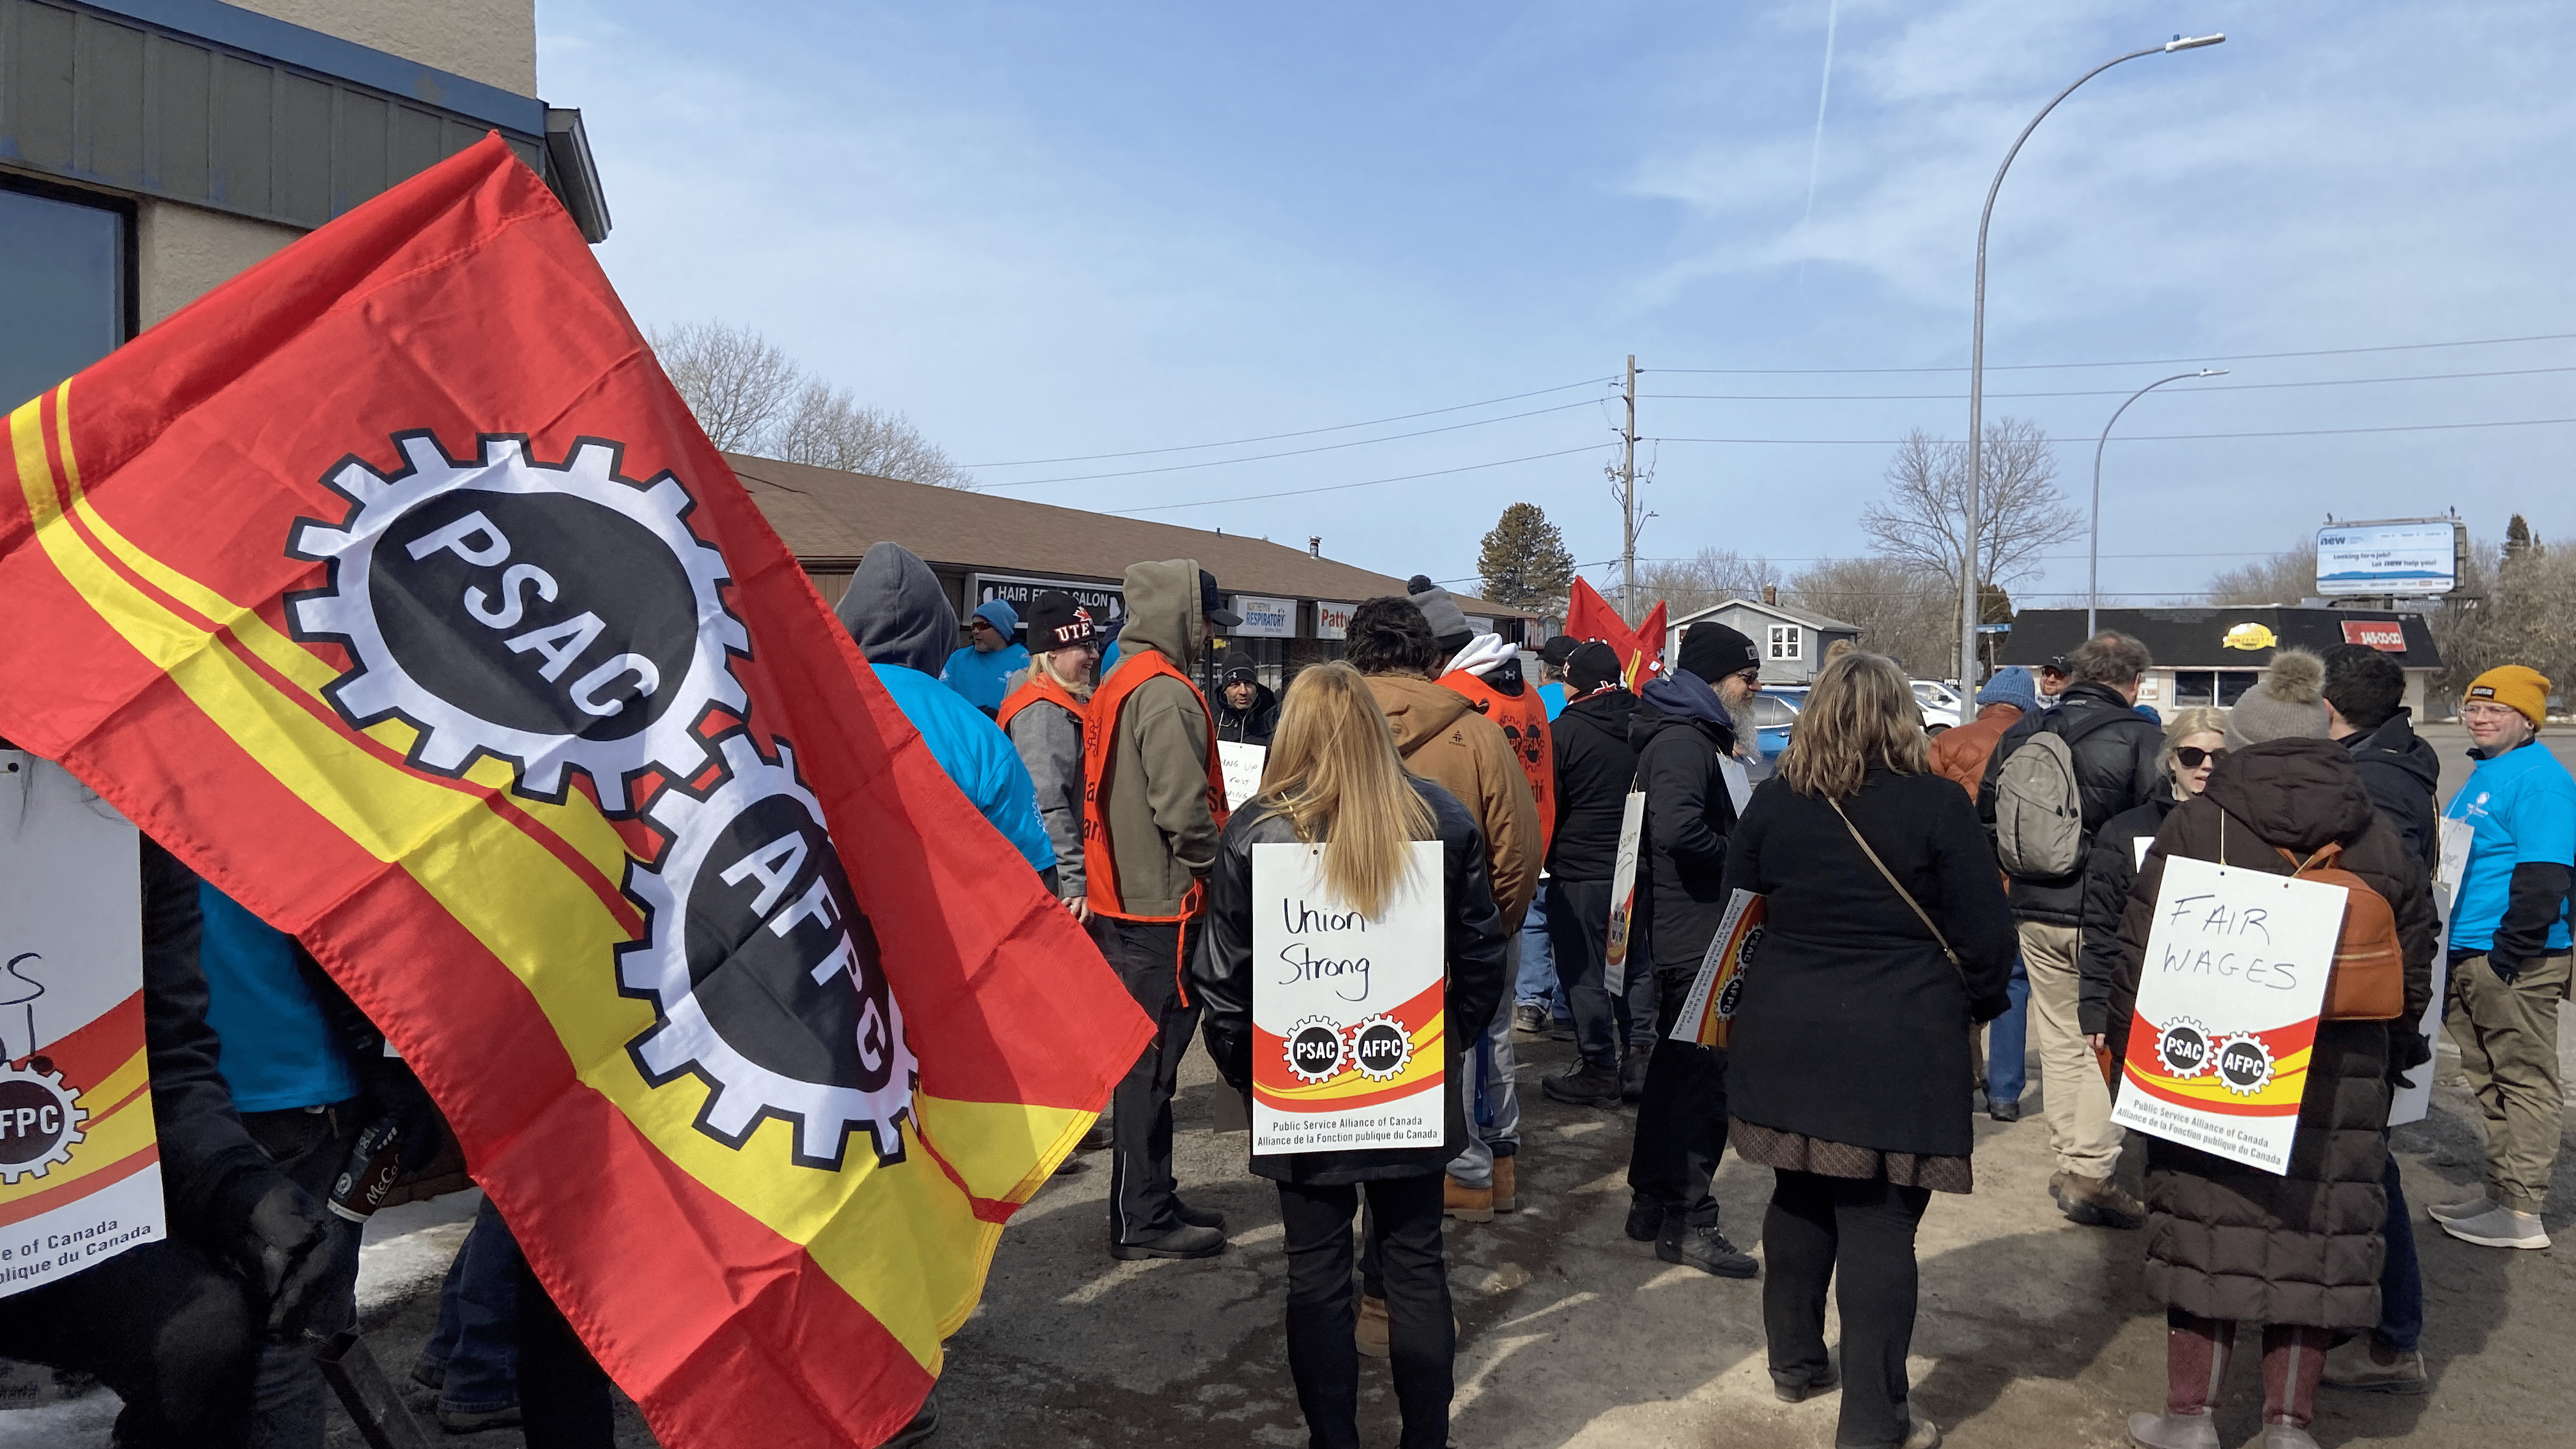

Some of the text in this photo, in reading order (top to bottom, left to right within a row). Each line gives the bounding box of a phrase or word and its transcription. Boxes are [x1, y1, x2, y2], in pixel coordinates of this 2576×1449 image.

[405, 509, 660, 717] PSAC
[998, 585, 1028, 602] HAIR
[1072, 590, 1108, 608] SALON
[1246, 611, 1286, 627] RESPIRATORY
[1283, 896, 1367, 935] Union
[2170, 894, 2271, 946] FAIR
[718, 829, 887, 1073] AFPC
[1743, 931, 1762, 962] PSAC
[1278, 942, 1370, 1002] Strong
[2162, 942, 2297, 990] WAGES
[1722, 981, 1740, 1013] AFPC
[1296, 1041, 1336, 1061] PSAC
[1361, 1038, 1401, 1058] AFPC
[2166, 1036, 2203, 1061] PSAC
[2224, 1052, 2264, 1078] AFPC
[0, 1105, 59, 1140] FPC
[1257, 1128, 1438, 1147] Alliance de la Fonction publique du Canada
[1273, 1115, 1422, 1132] Public Service Alliance of Canada
[2116, 1107, 2281, 1166] Alliance de la Fonction publique du Canada
[2134, 1099, 2269, 1148] Public Service Alliance of Canada
[21, 1239, 40, 1256] of
[48, 1220, 118, 1250] Canada
[58, 1251, 79, 1267] du
[86, 1225, 151, 1257] Canada
